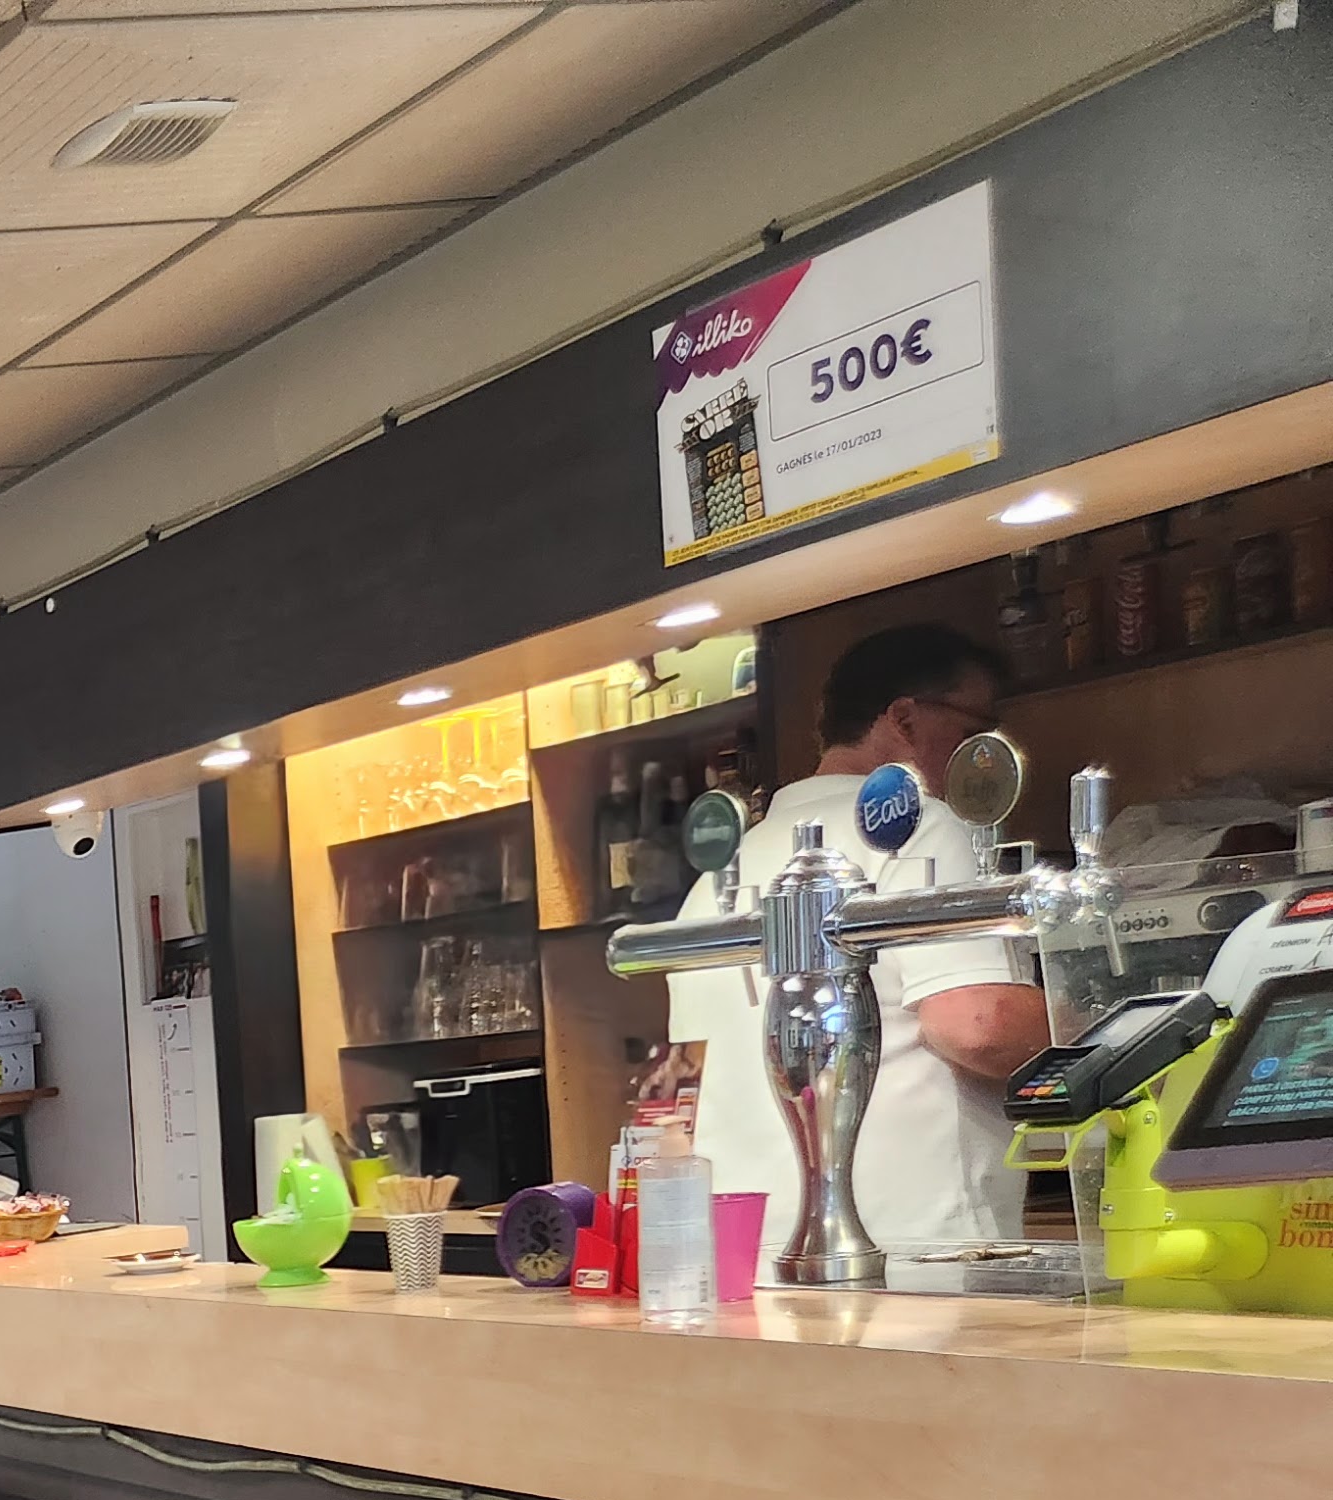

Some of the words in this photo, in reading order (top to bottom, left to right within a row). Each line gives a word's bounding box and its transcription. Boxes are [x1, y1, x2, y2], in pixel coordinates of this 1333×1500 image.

[691, 308, 754, 359] illiko
[809, 316, 933, 404] 500€
[825, 427, 883, 459] 17/01/2023
